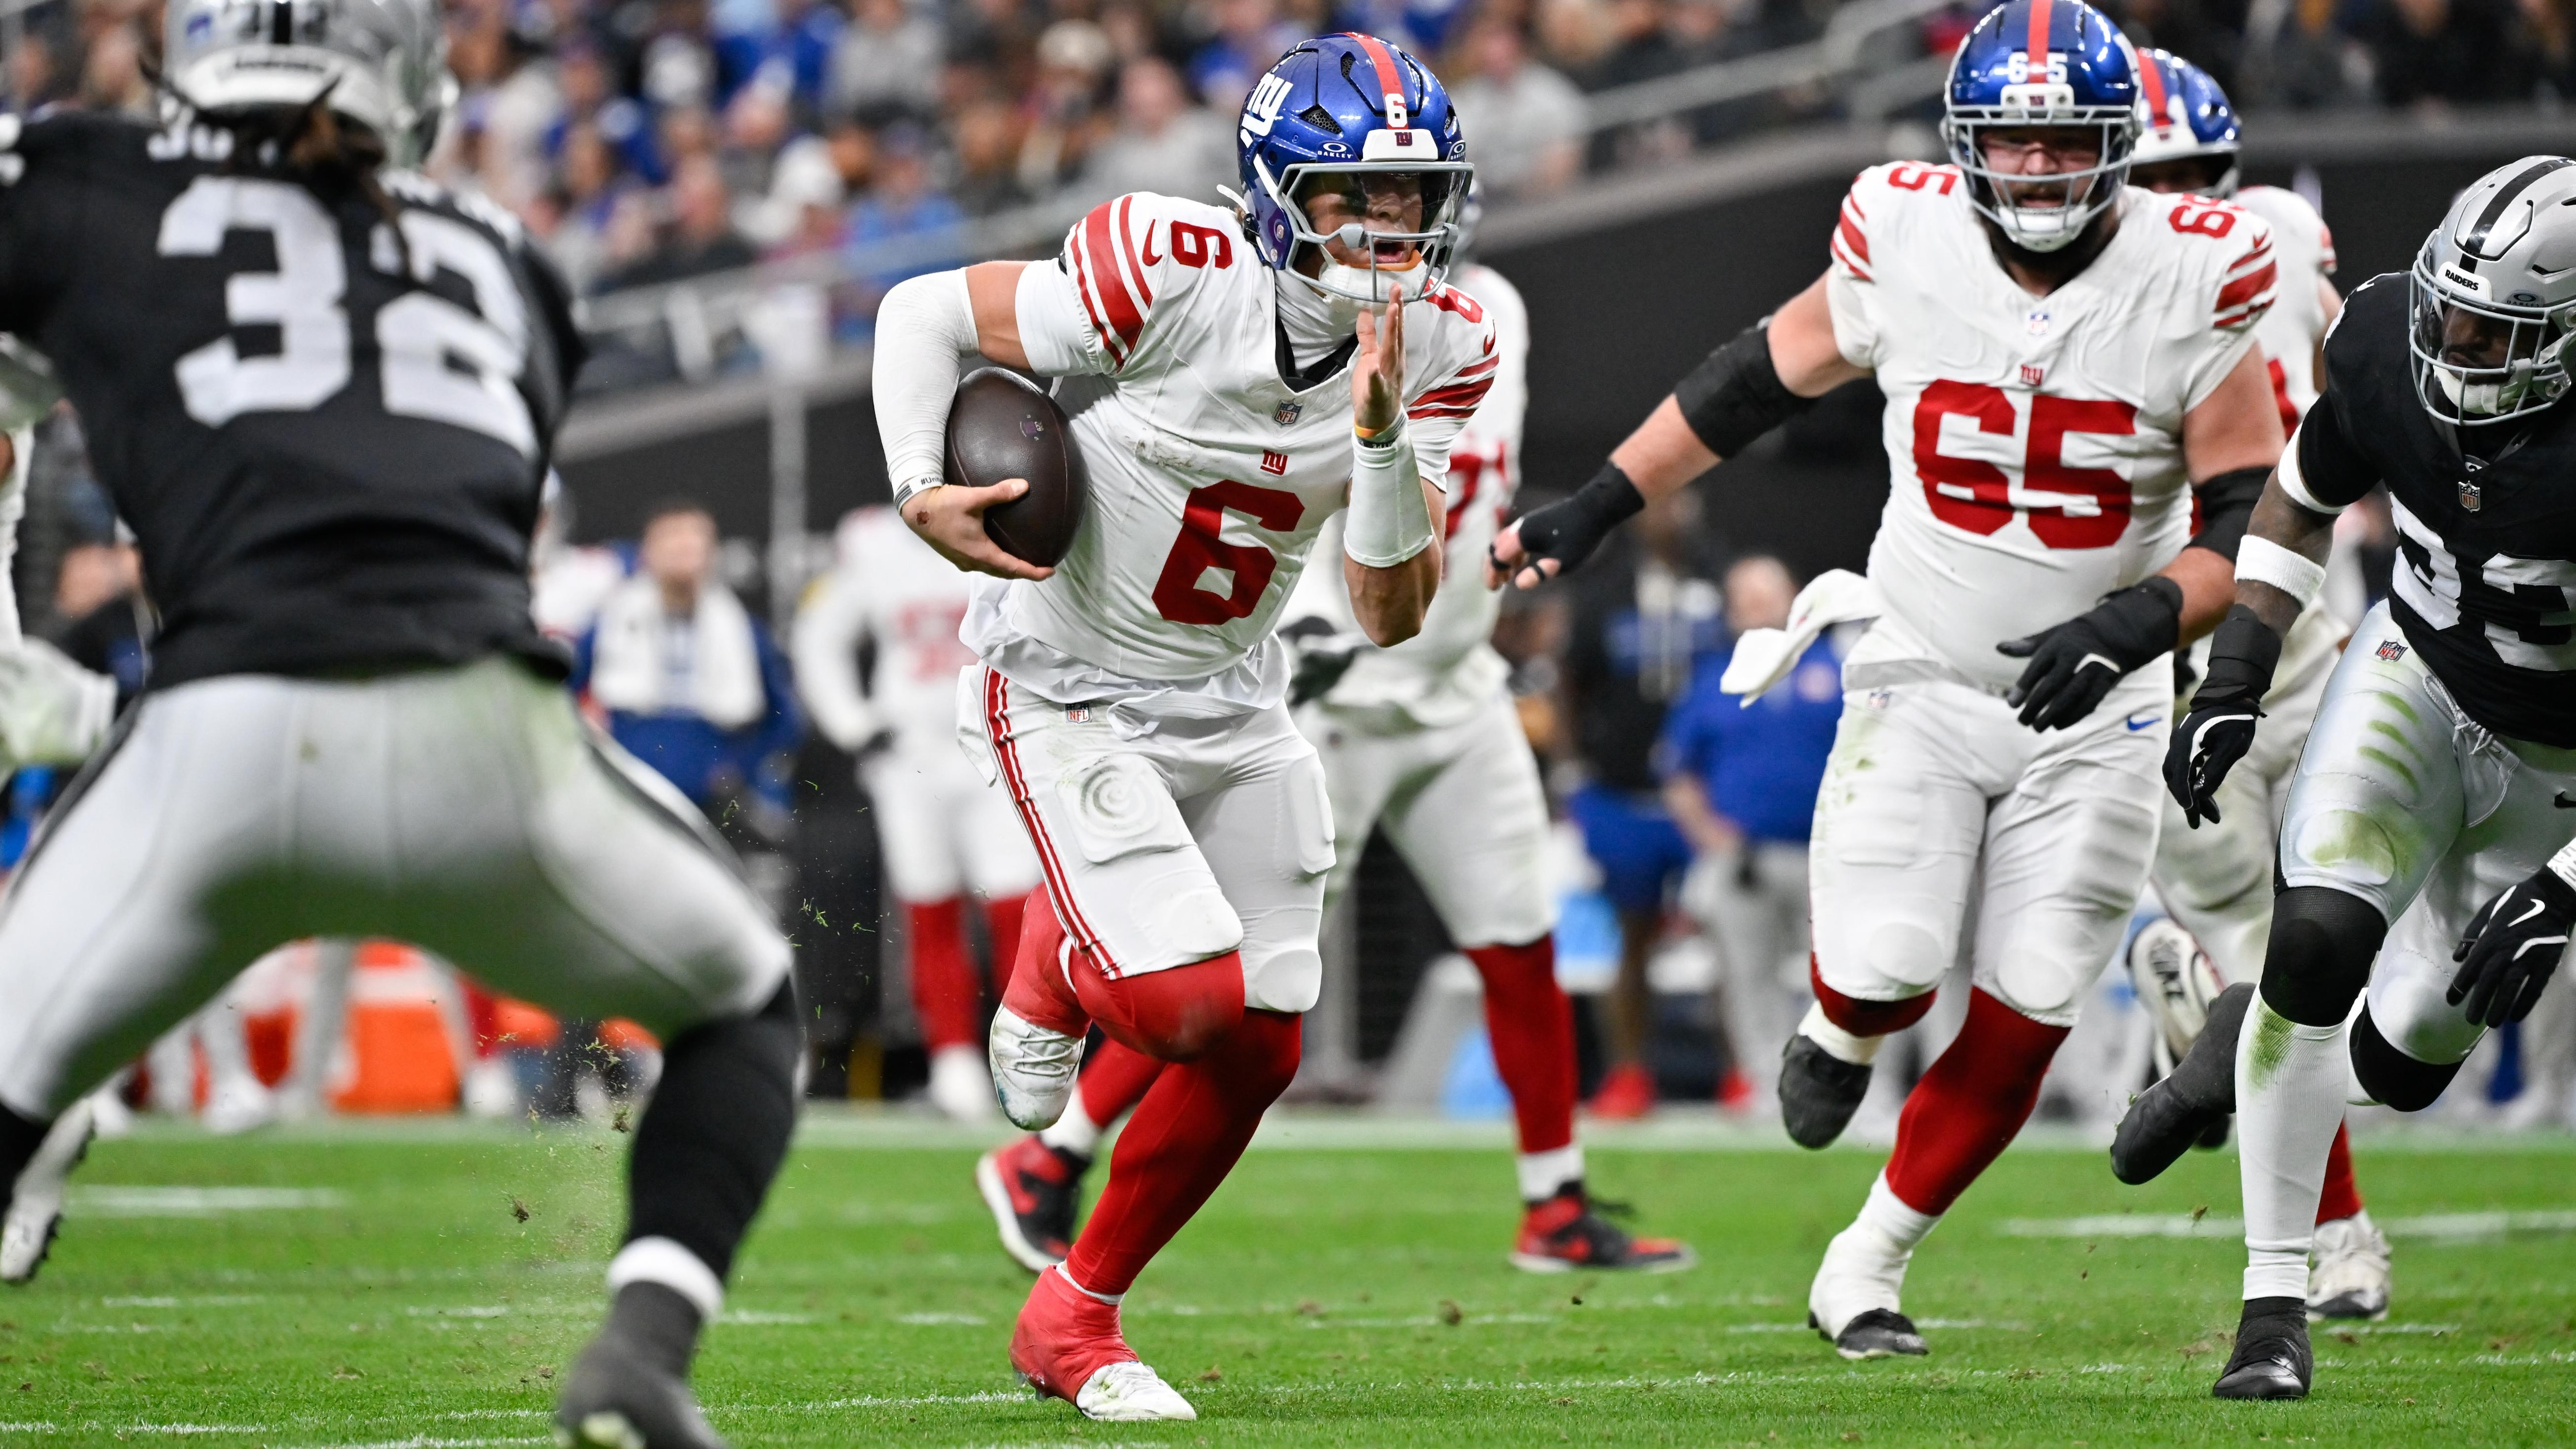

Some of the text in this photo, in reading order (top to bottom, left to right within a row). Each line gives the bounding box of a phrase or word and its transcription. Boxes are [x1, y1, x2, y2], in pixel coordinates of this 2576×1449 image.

[2008, 52, 2067, 83] 65
[1384, 93, 1408, 128] 6
[1317, 150, 1353, 159] OAKLEY
[1888, 160, 1958, 195] 5
[1170, 219, 1233, 269] 6
[2445, 269, 2479, 291] RAIDERS
[156, 175, 536, 459] 32
[1276, 411, 1295, 423] NFL
[1913, 379, 2137, 549] 65
[2463, 495, 2477, 507] NFL
[1151, 480, 1305, 625] 6
[2389, 491, 2576, 672] 33
[2379, 647, 2396, 658] NFL
[1069, 710, 1088, 722] NFL
